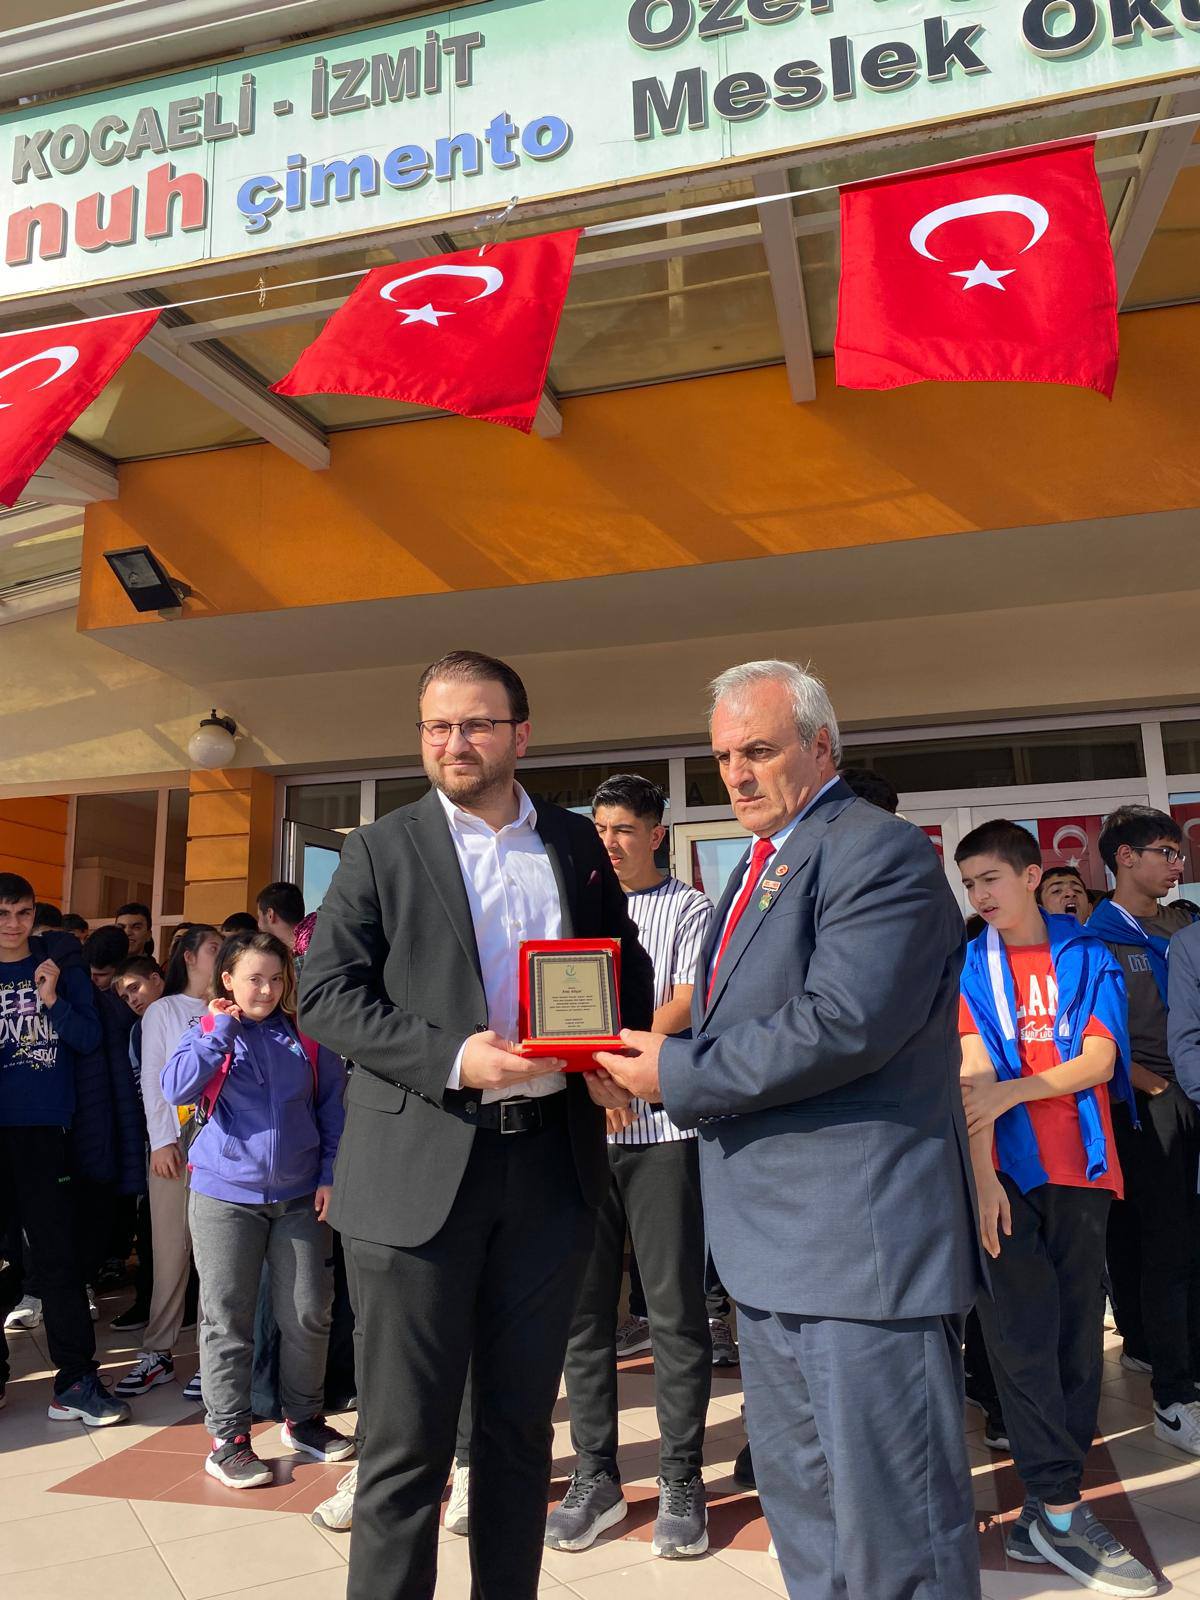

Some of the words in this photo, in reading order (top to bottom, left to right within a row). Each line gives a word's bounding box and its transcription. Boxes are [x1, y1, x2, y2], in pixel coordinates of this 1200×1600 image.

[12, 73, 256, 183] KOCAELİ
[273, 99, 293, 116] -
[311, 30, 485, 118] İZMİT
[632, 16, 989, 140] Meslek
[6, 162, 206, 266] nuh
[237, 111, 572, 233] çimento
